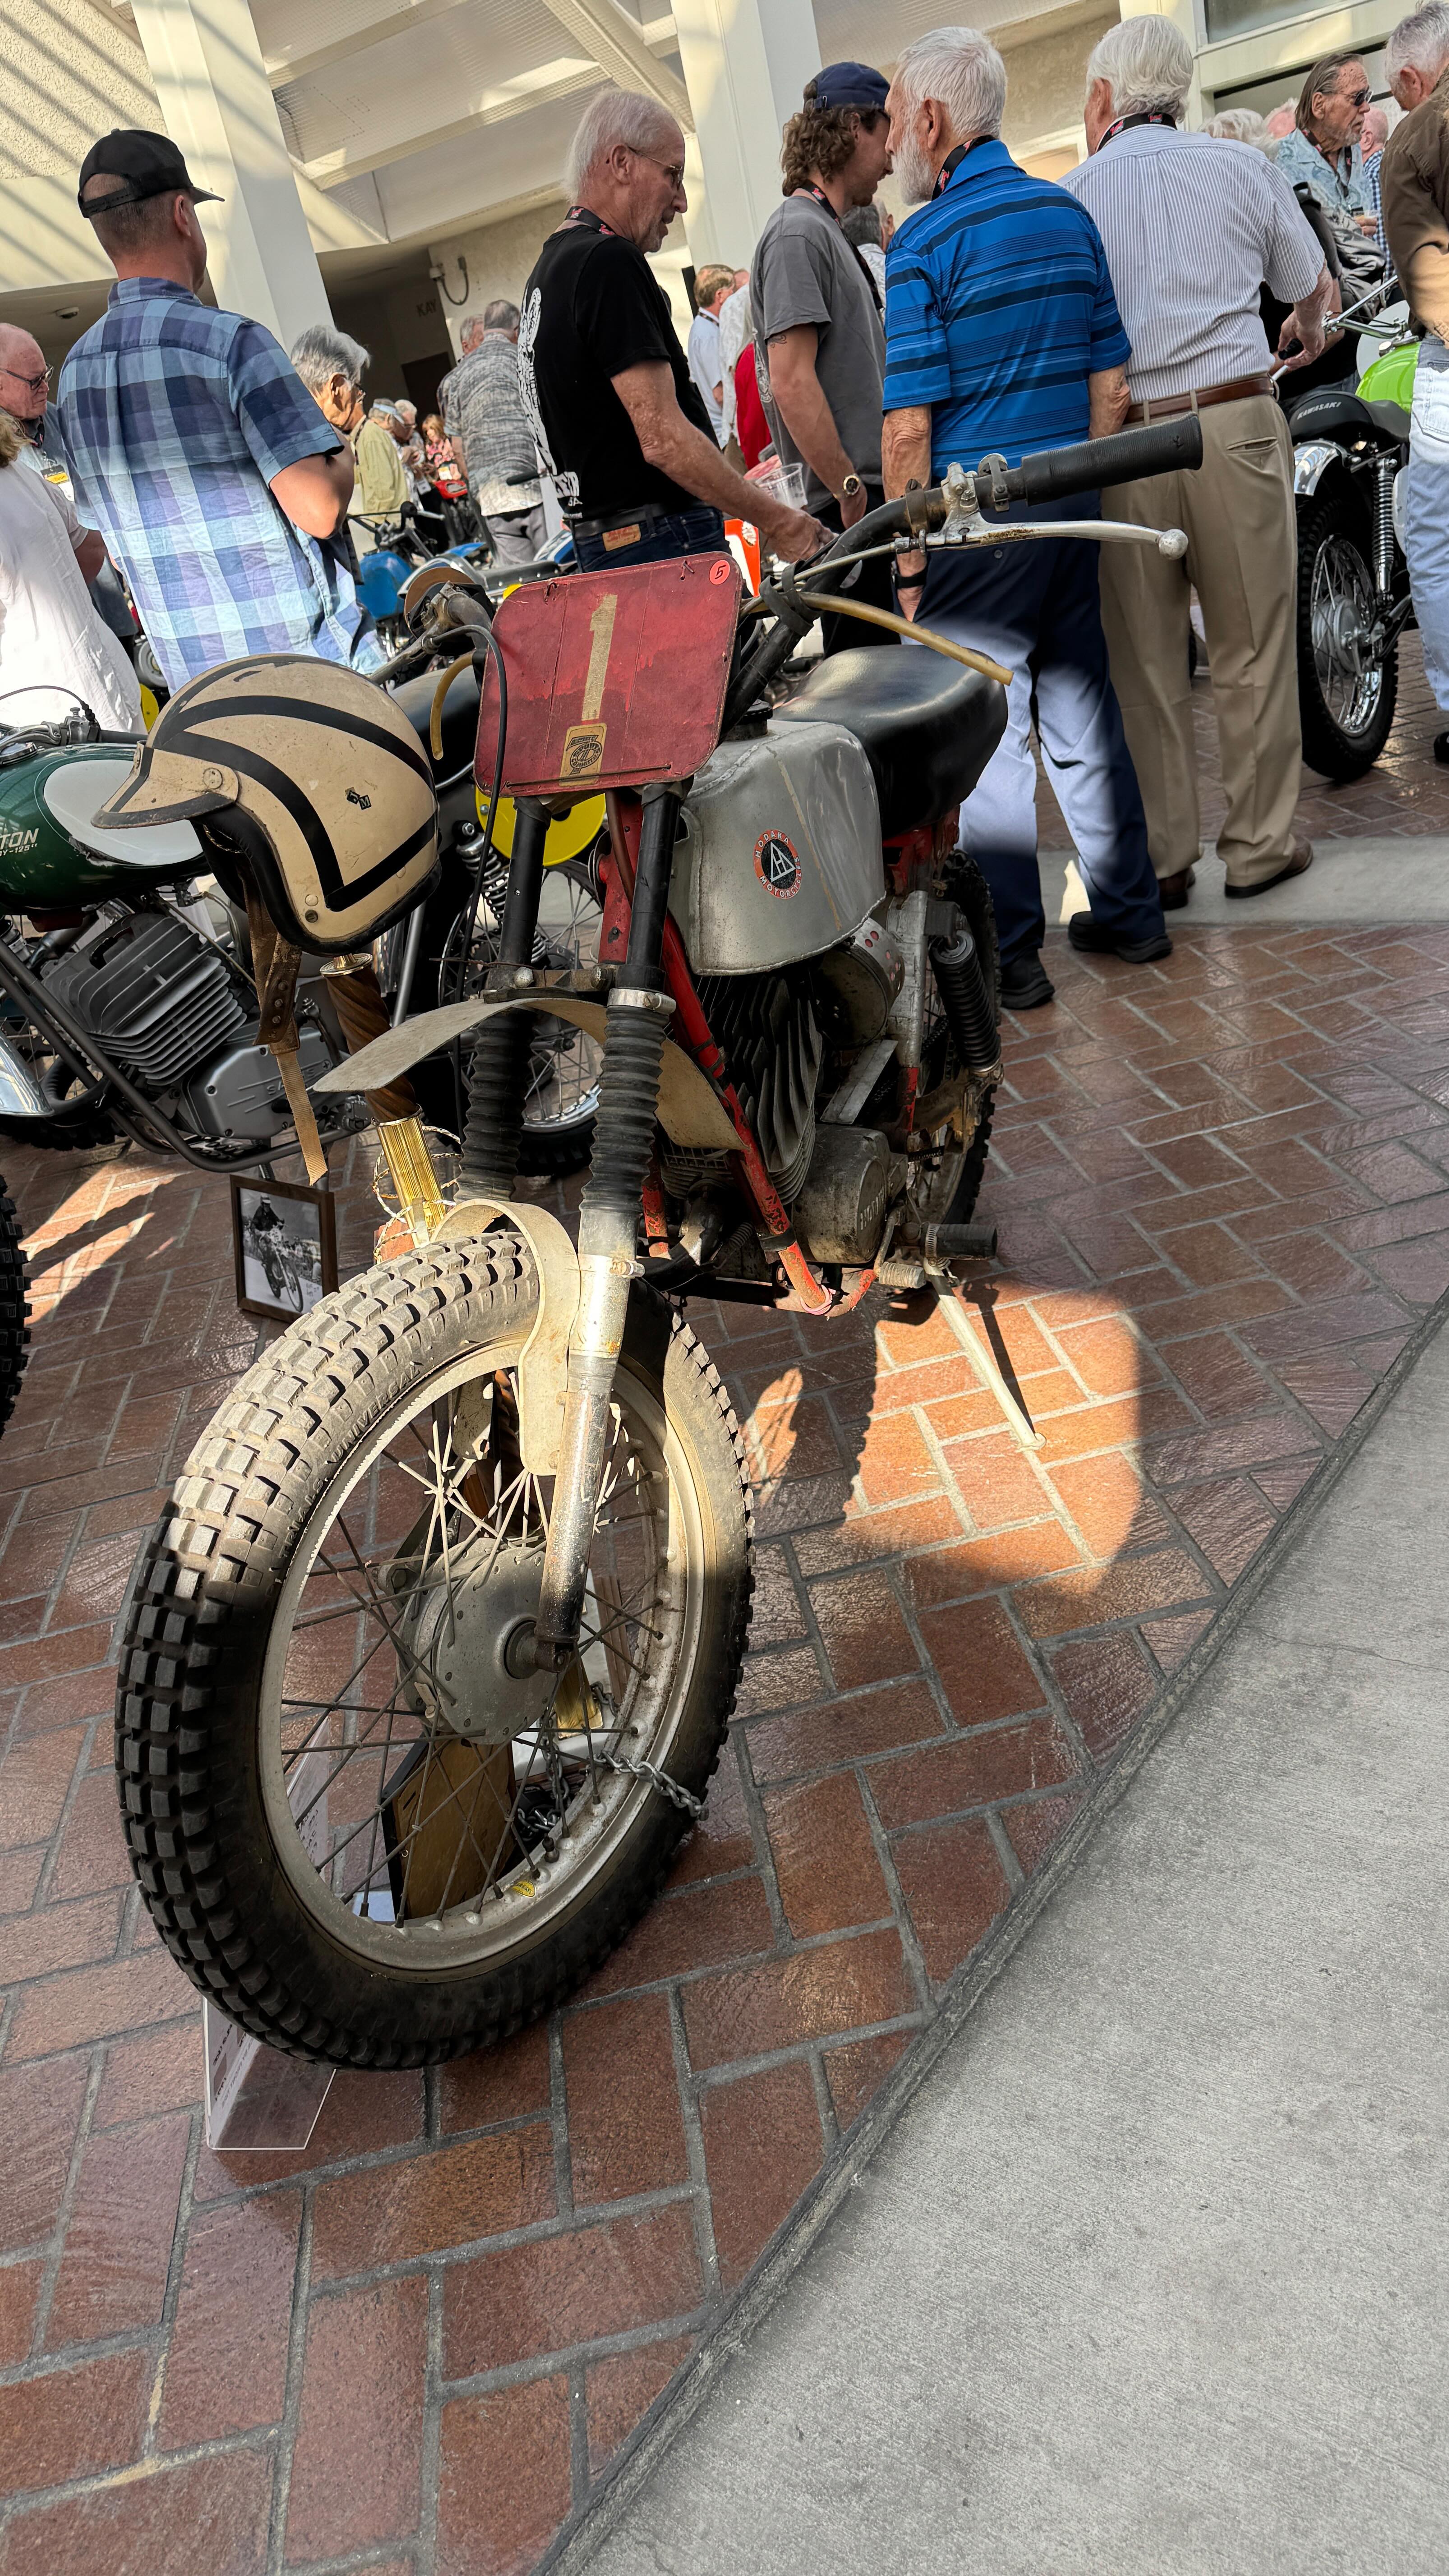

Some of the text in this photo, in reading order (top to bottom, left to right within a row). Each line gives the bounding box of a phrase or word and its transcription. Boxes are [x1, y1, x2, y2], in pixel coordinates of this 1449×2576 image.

[1297, 401, 1342, 420] KAWASAKI
[715, 565, 727, 580] 5
[581, 593, 618, 721] 1
[360, 796, 371, 808] M
[755, 830, 789, 858] HODAKA
[760, 856, 802, 897] MOTORCYCLES
[278, 1366, 420, 1558] TRIALS UNIVERSAL
